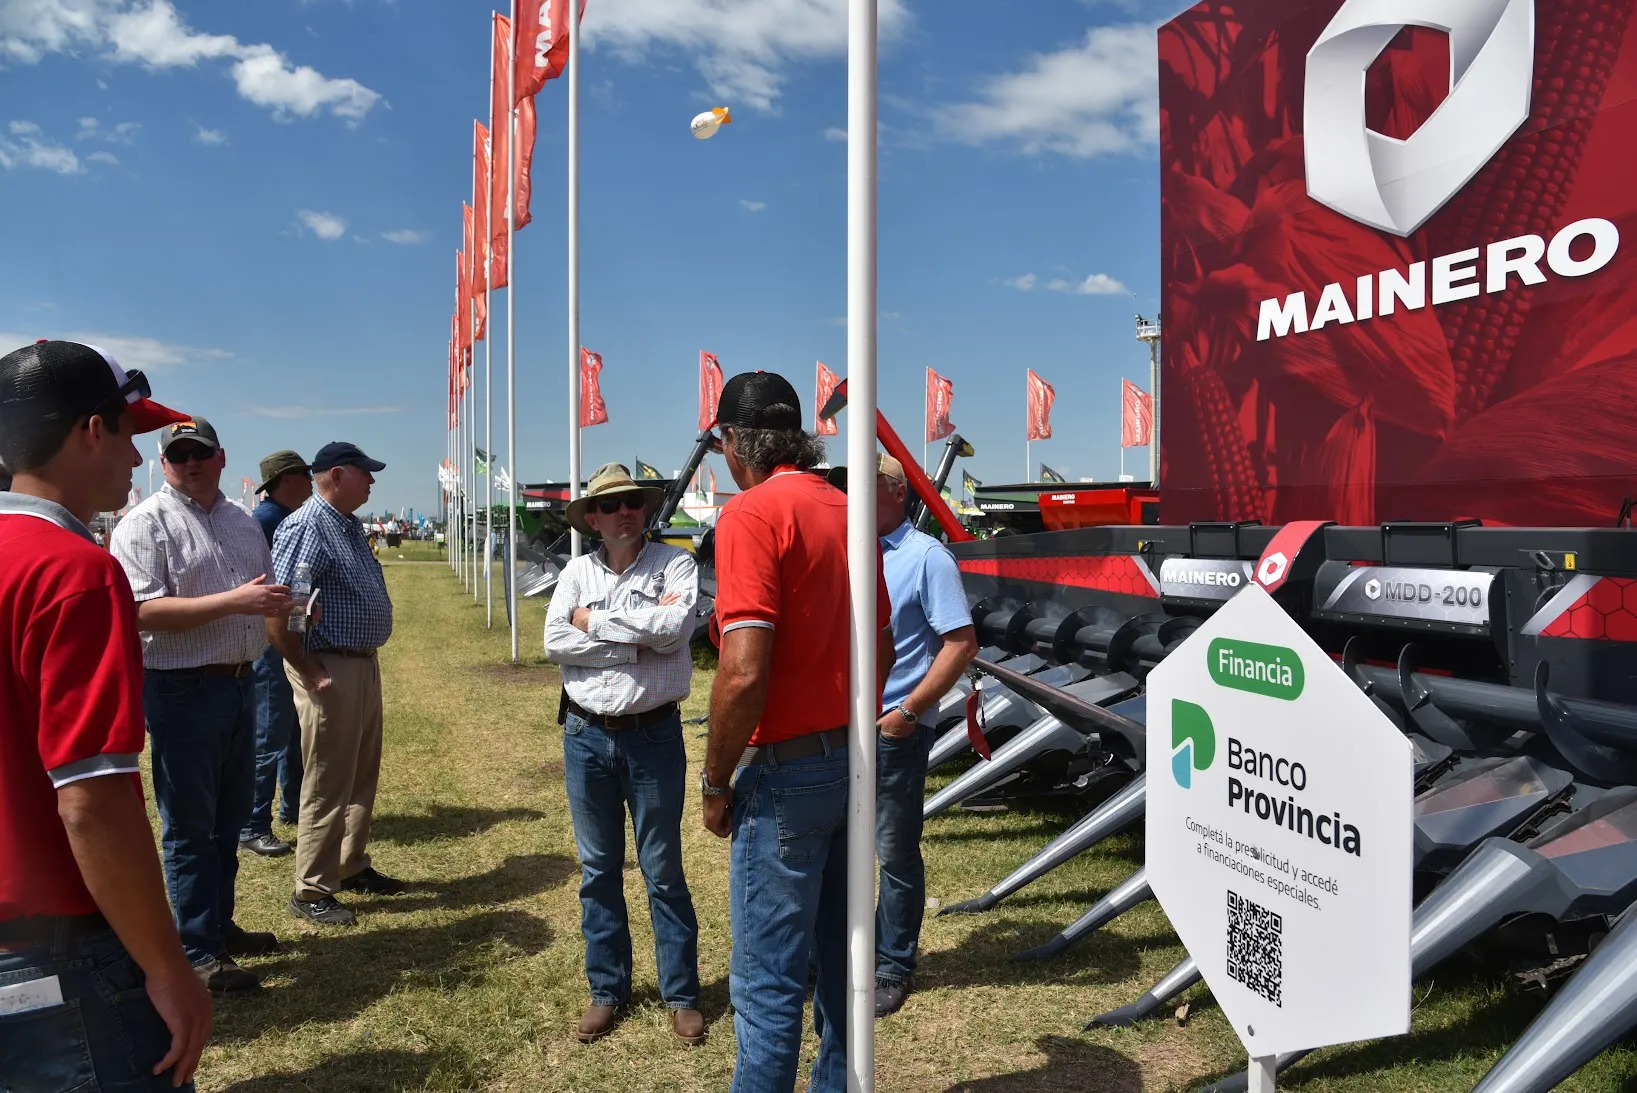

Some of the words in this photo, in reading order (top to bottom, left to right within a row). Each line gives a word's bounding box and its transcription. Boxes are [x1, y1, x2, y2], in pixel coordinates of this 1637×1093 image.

[1256, 217, 1620, 341] MAINERO
[1163, 569, 1241, 587] MAINERO
[1385, 581, 1482, 608] MDD-200
[1218, 648, 1293, 687] Financia
[1228, 737, 1307, 791] Banco
[1228, 776, 1361, 857] Provincia
[1185, 816, 1224, 845] Completá
[1225, 832, 1233, 849] la
[1236, 841, 1290, 874] preslicitud
[1292, 865, 1299, 880] y
[1301, 869, 1339, 896] accedé
[1197, 845, 1202, 854] a
[1203, 843, 1265, 884] financiaciones
[1267, 875, 1322, 911] especiales.
